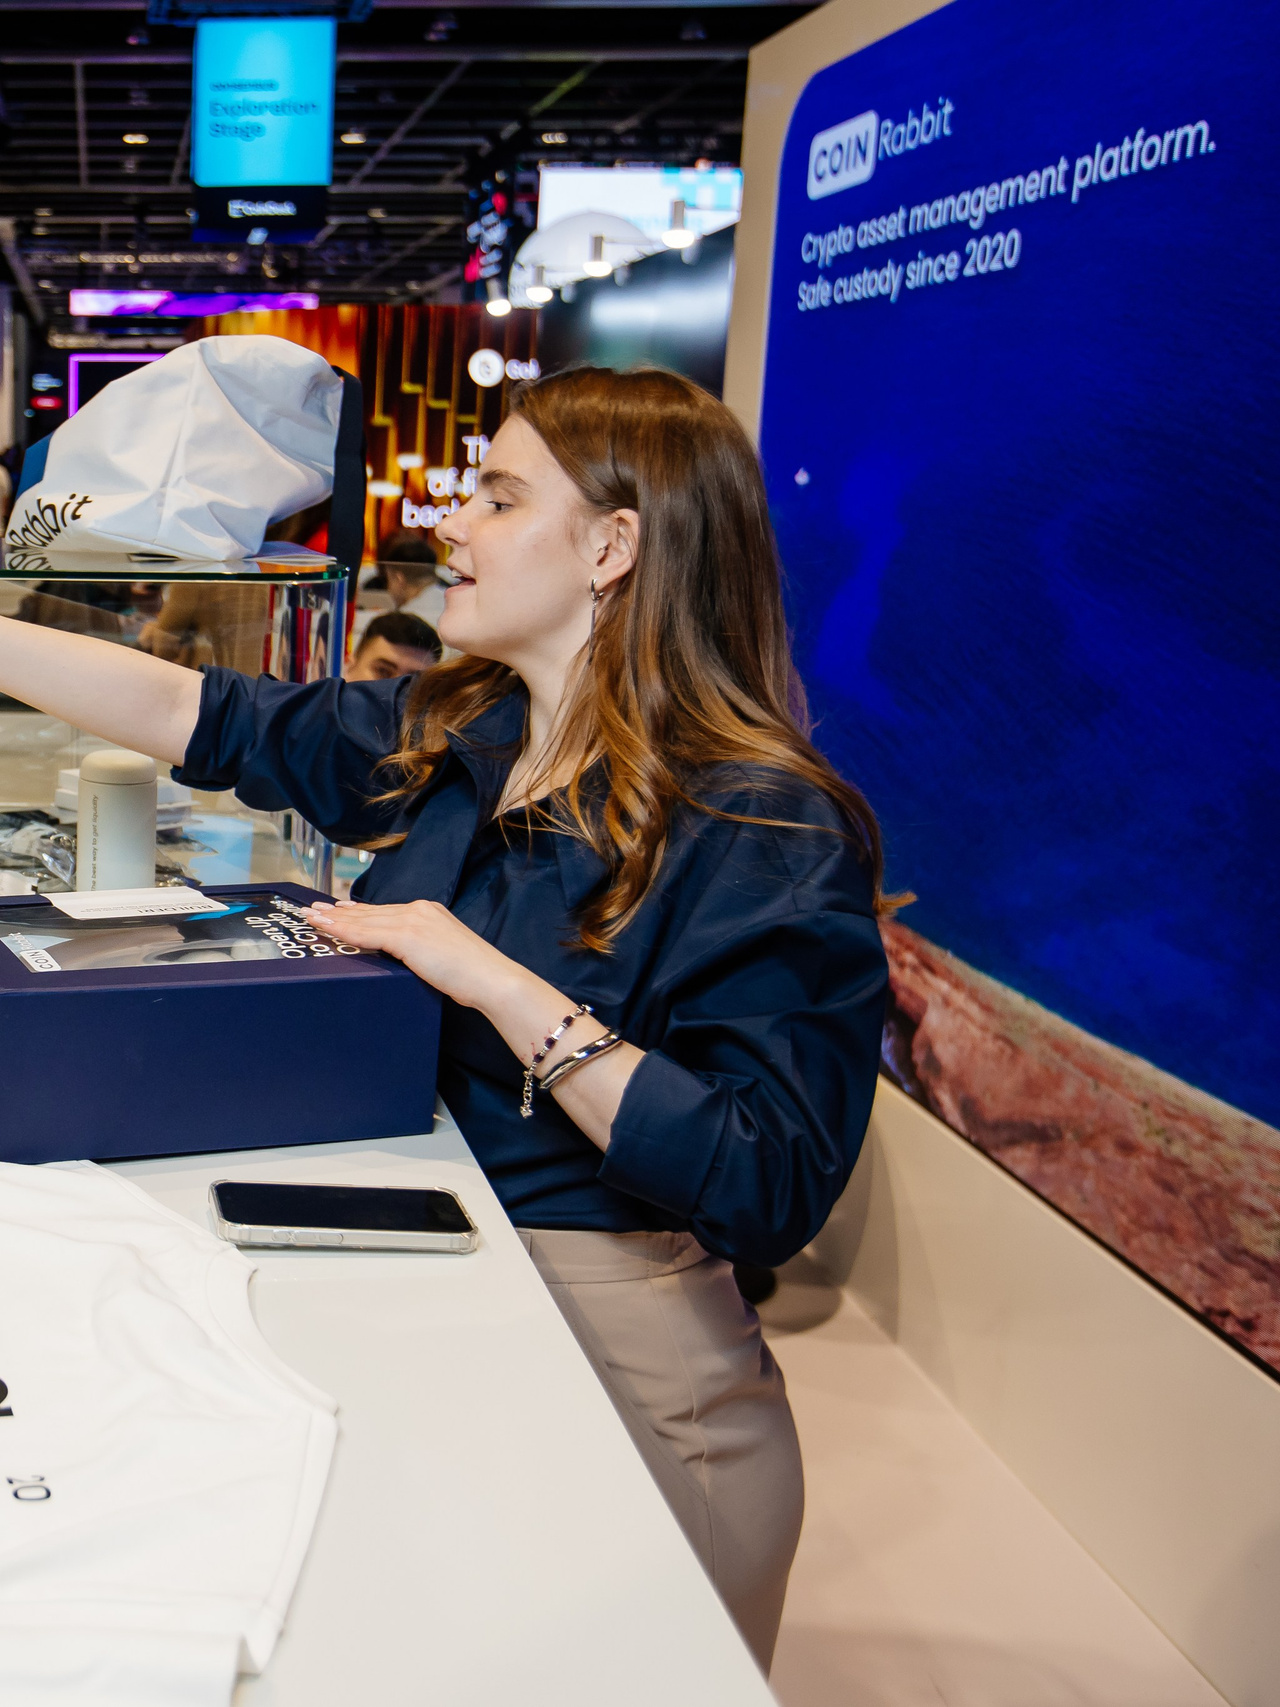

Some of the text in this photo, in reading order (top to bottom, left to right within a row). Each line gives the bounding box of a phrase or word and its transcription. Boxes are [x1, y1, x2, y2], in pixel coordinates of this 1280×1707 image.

[209, 121, 266, 142] Stage
[813, 96, 955, 183] COIN Rabbit
[801, 119, 1217, 268] Crypto asset management platform.
[797, 227, 1023, 312] Safe custody since 2020
[427, 466, 459, 498] of
[91, 824, 99, 838] get
[91, 838, 97, 846] to
[244, 916, 272, 928] Up
[267, 912, 319, 943] Crypto
[261, 926, 307, 959] Open
[309, 943, 335, 958] to
[26, 949, 54, 970] COIN
